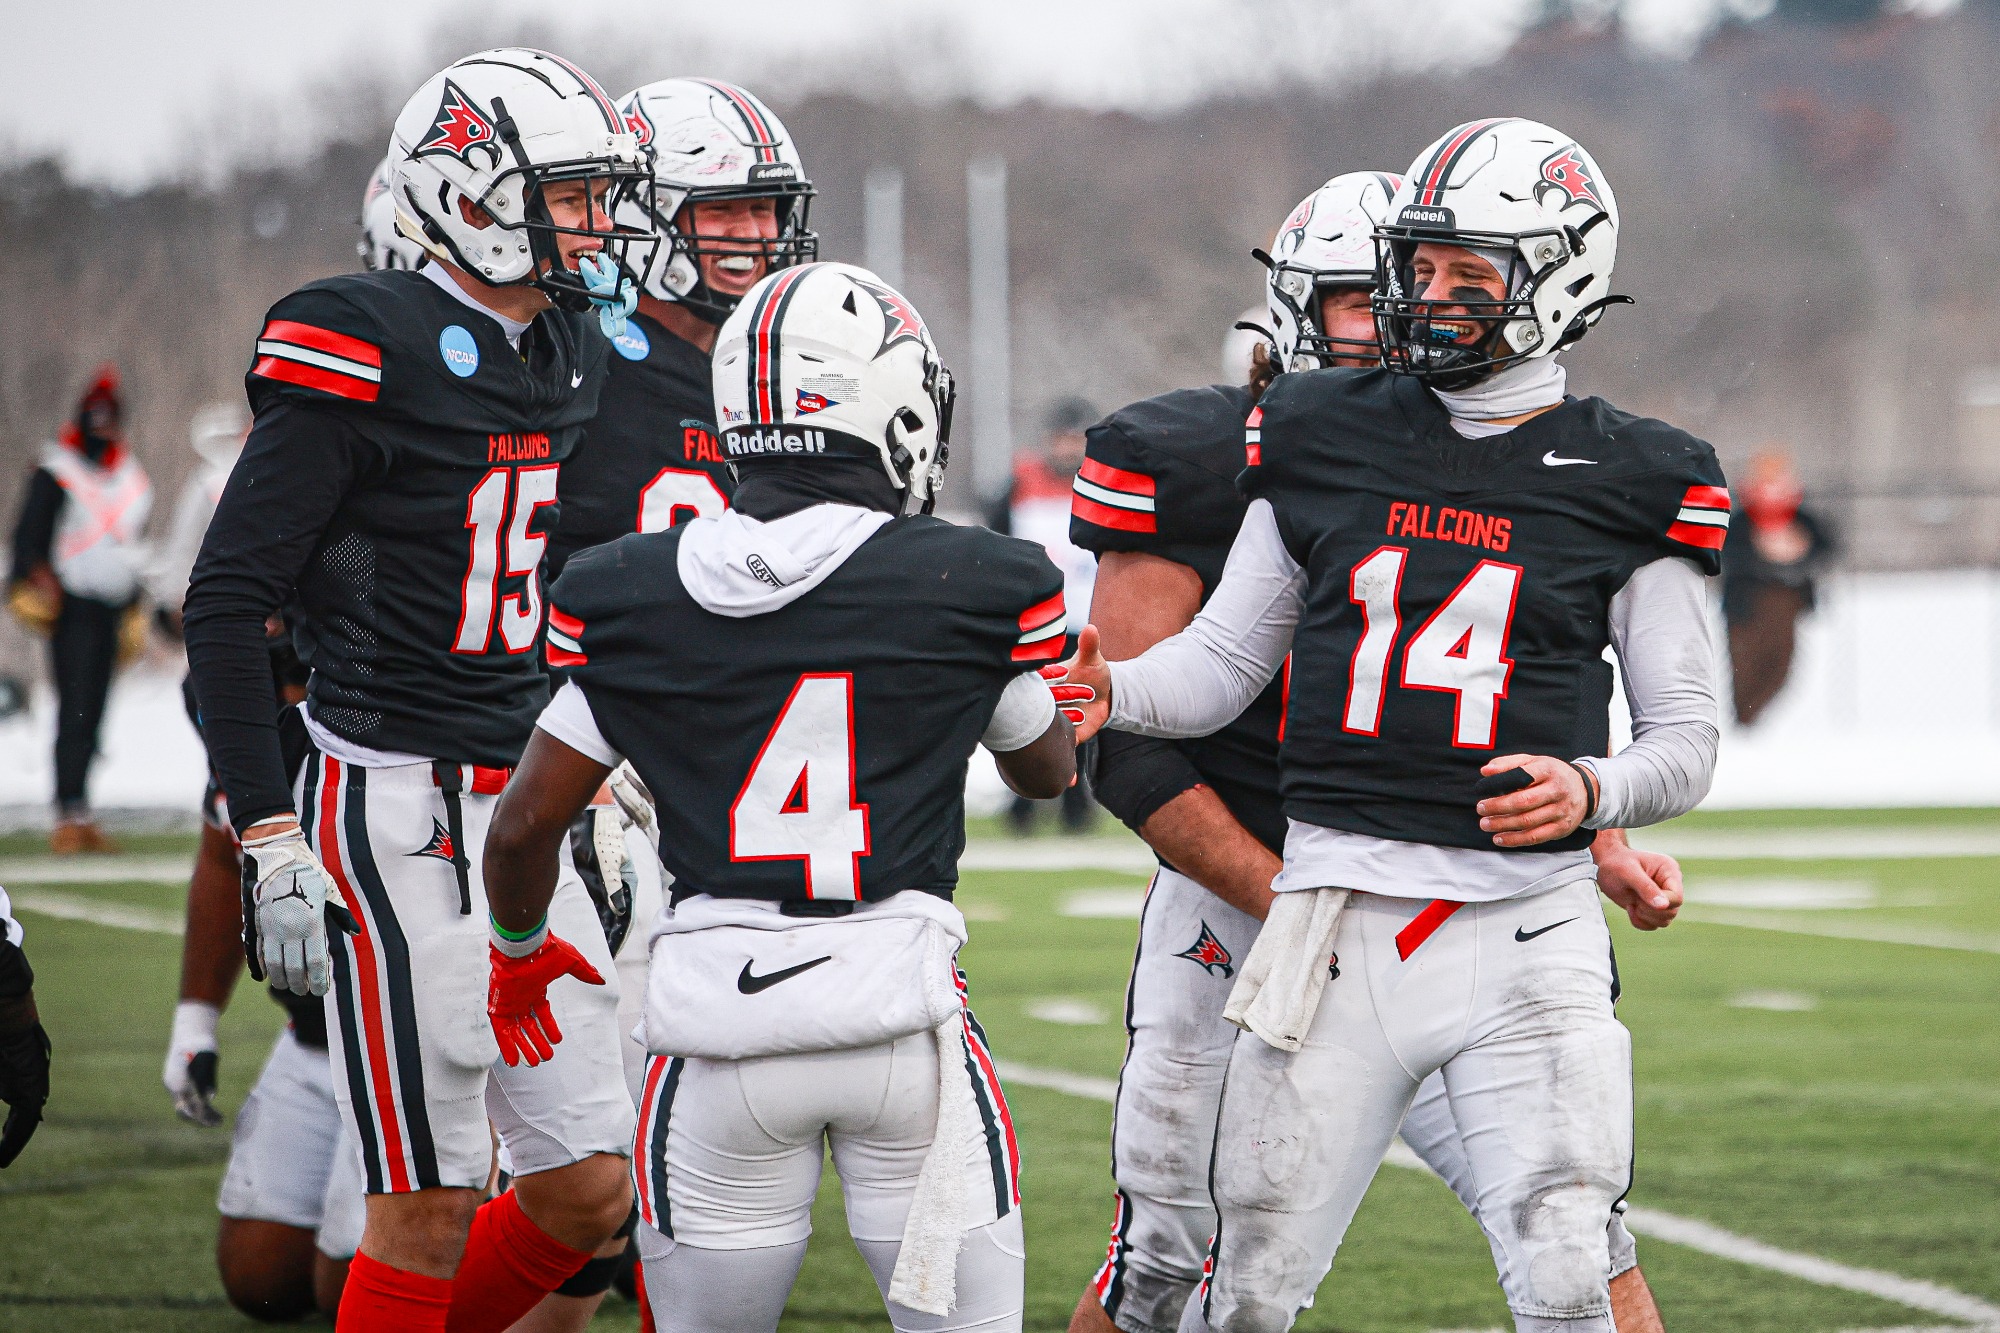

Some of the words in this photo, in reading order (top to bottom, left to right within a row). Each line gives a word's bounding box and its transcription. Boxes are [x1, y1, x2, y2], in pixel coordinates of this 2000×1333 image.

[446, 348, 478, 366] NCAA
[684, 427, 725, 462] FAL
[726, 429, 826, 455] Riddell
[1386, 501, 1513, 553] FALCONS
[450, 462, 560, 655] 15
[1342, 545, 1525, 750] 14
[729, 671, 871, 901] 4
